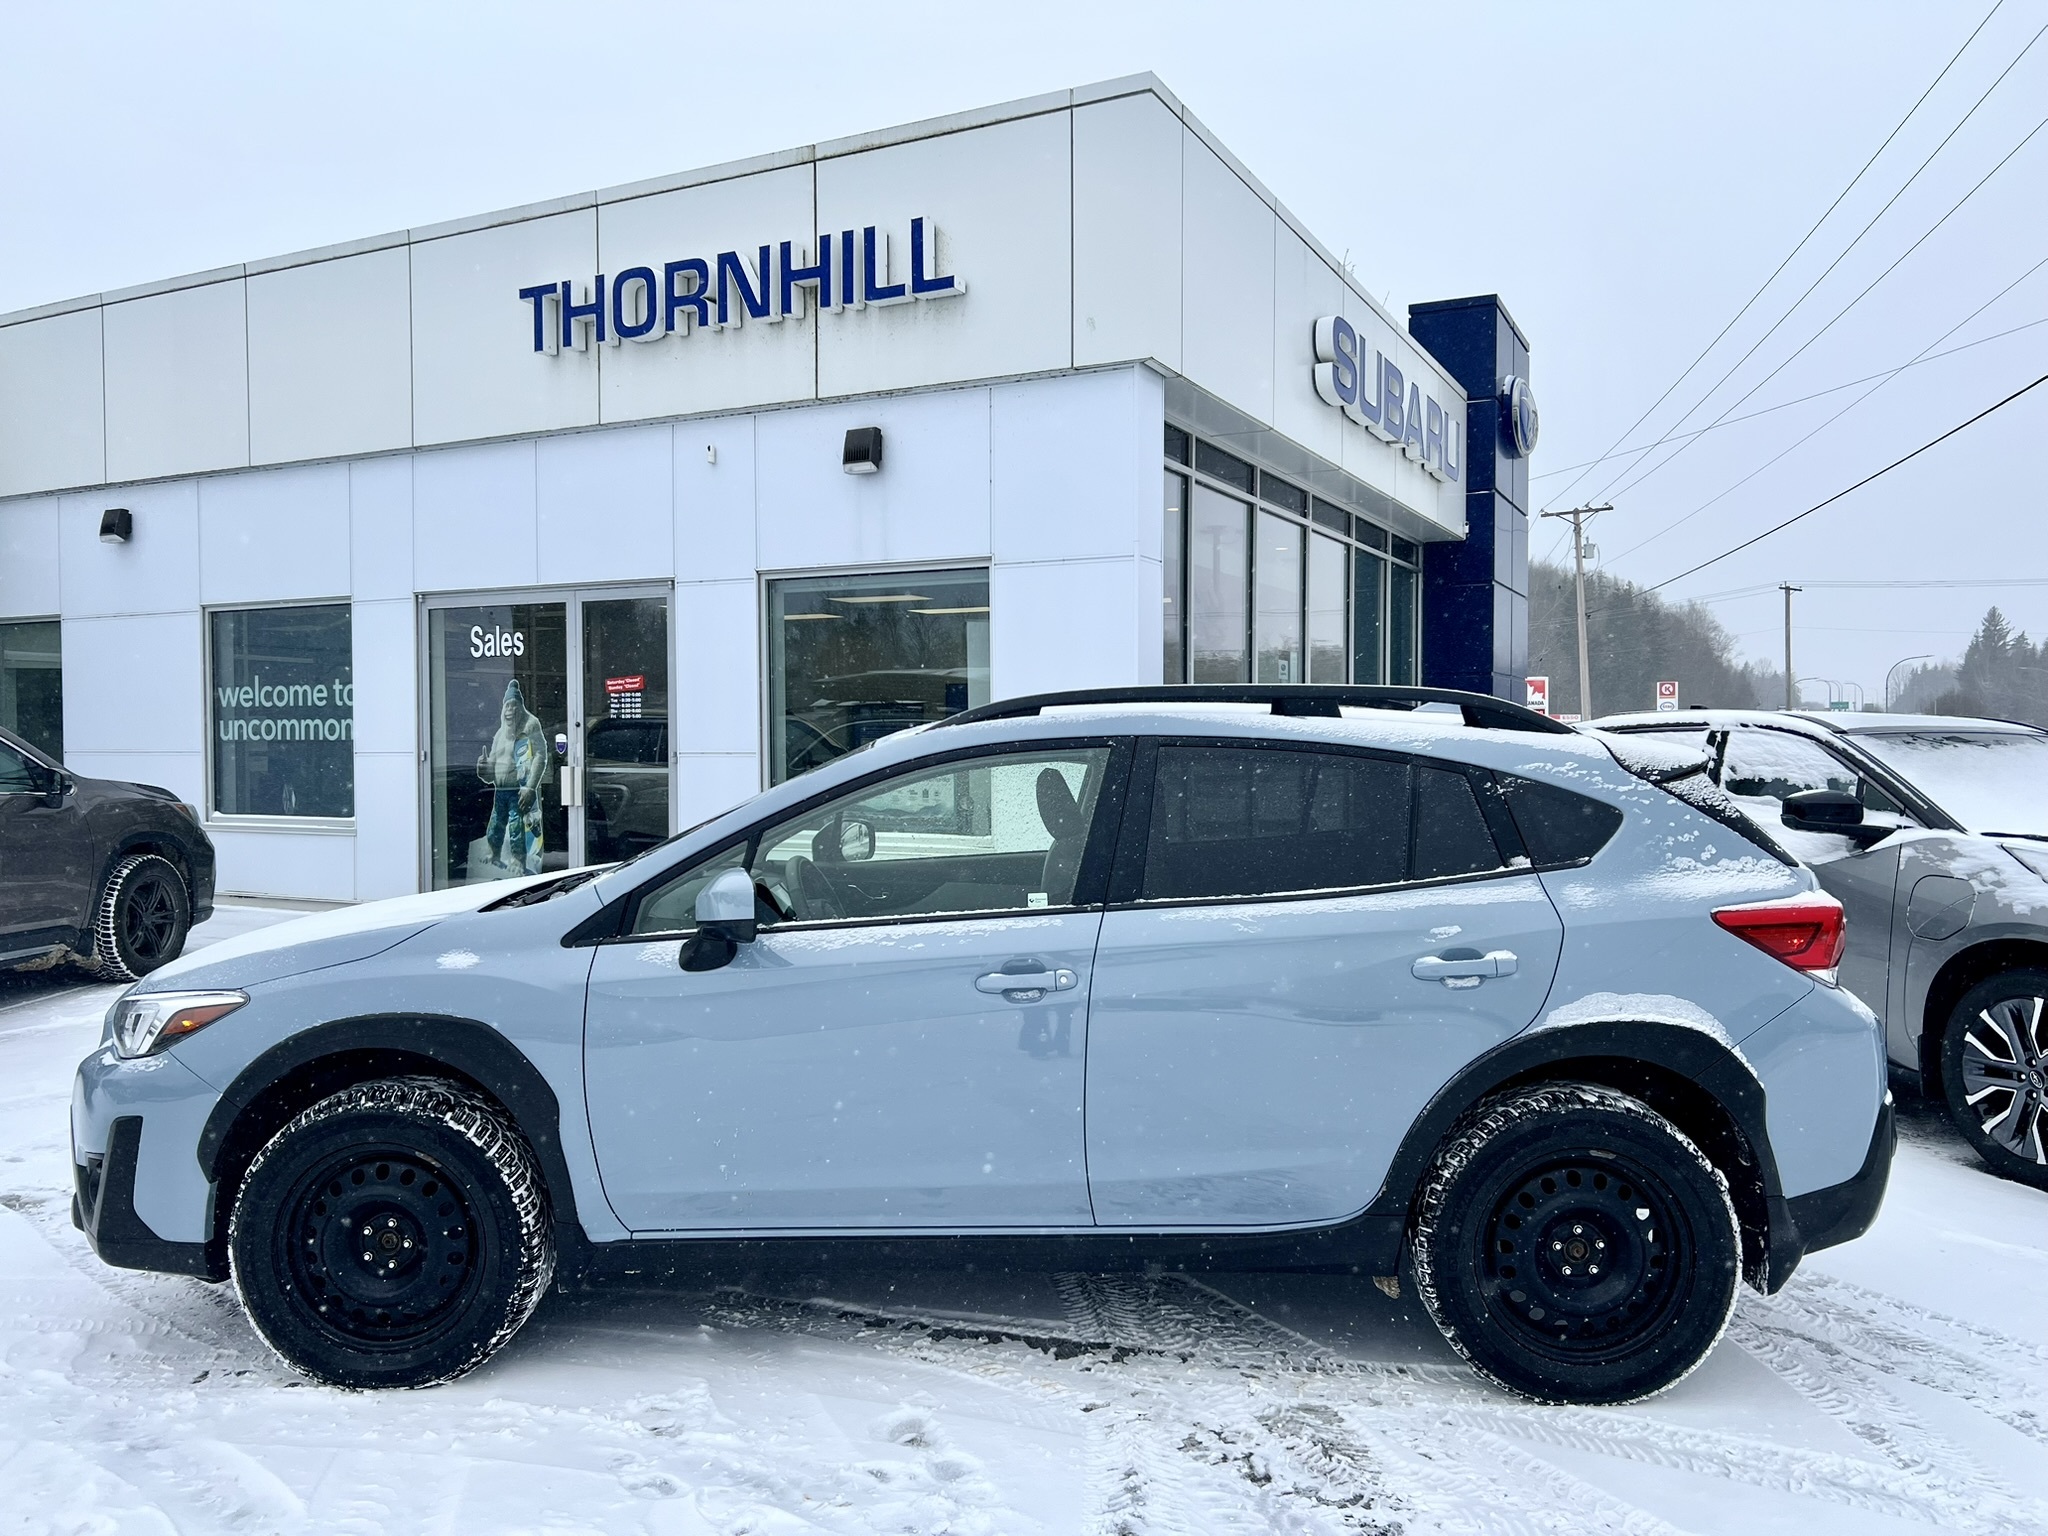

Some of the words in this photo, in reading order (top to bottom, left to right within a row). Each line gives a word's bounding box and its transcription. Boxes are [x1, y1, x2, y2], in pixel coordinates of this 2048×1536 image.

[519, 216, 960, 354] THORNHILL
[1330, 315, 1461, 483] SUBARU
[470, 624, 524, 658] Sales
[218, 675, 328, 708] welcome
[332, 678, 353, 707] to
[219, 717, 353, 741] uncommon
